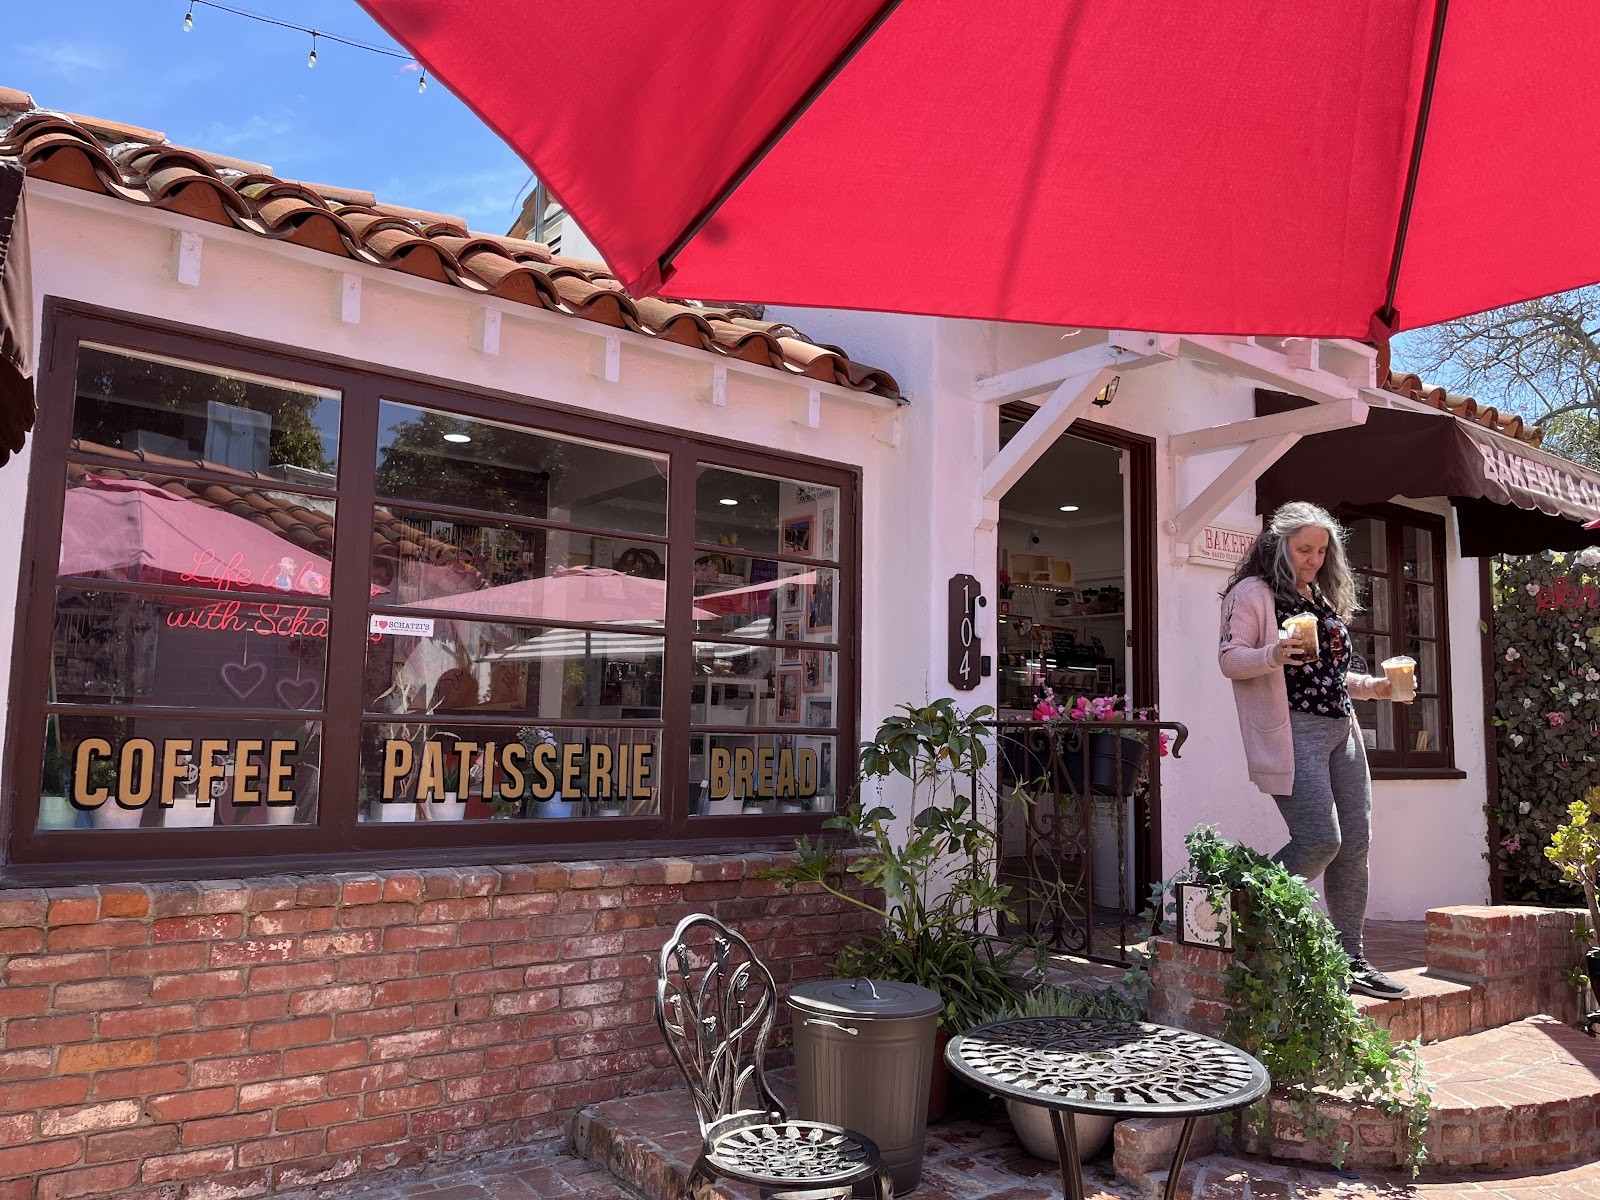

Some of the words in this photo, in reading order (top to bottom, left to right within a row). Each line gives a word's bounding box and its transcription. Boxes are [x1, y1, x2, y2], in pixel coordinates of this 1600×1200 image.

[1480, 443, 1564, 501] BAKERY
[1565, 473, 1584, 506] &
[181, 548, 255, 591] Life
[167, 600, 247, 631] with
[388, 621, 430, 631] SCHATZI'S
[959, 584, 973, 681] 104
[70, 737, 299, 811] COFFEE
[379, 738, 658, 804] PATISSERIE
[707, 746, 819, 801] BREAD
